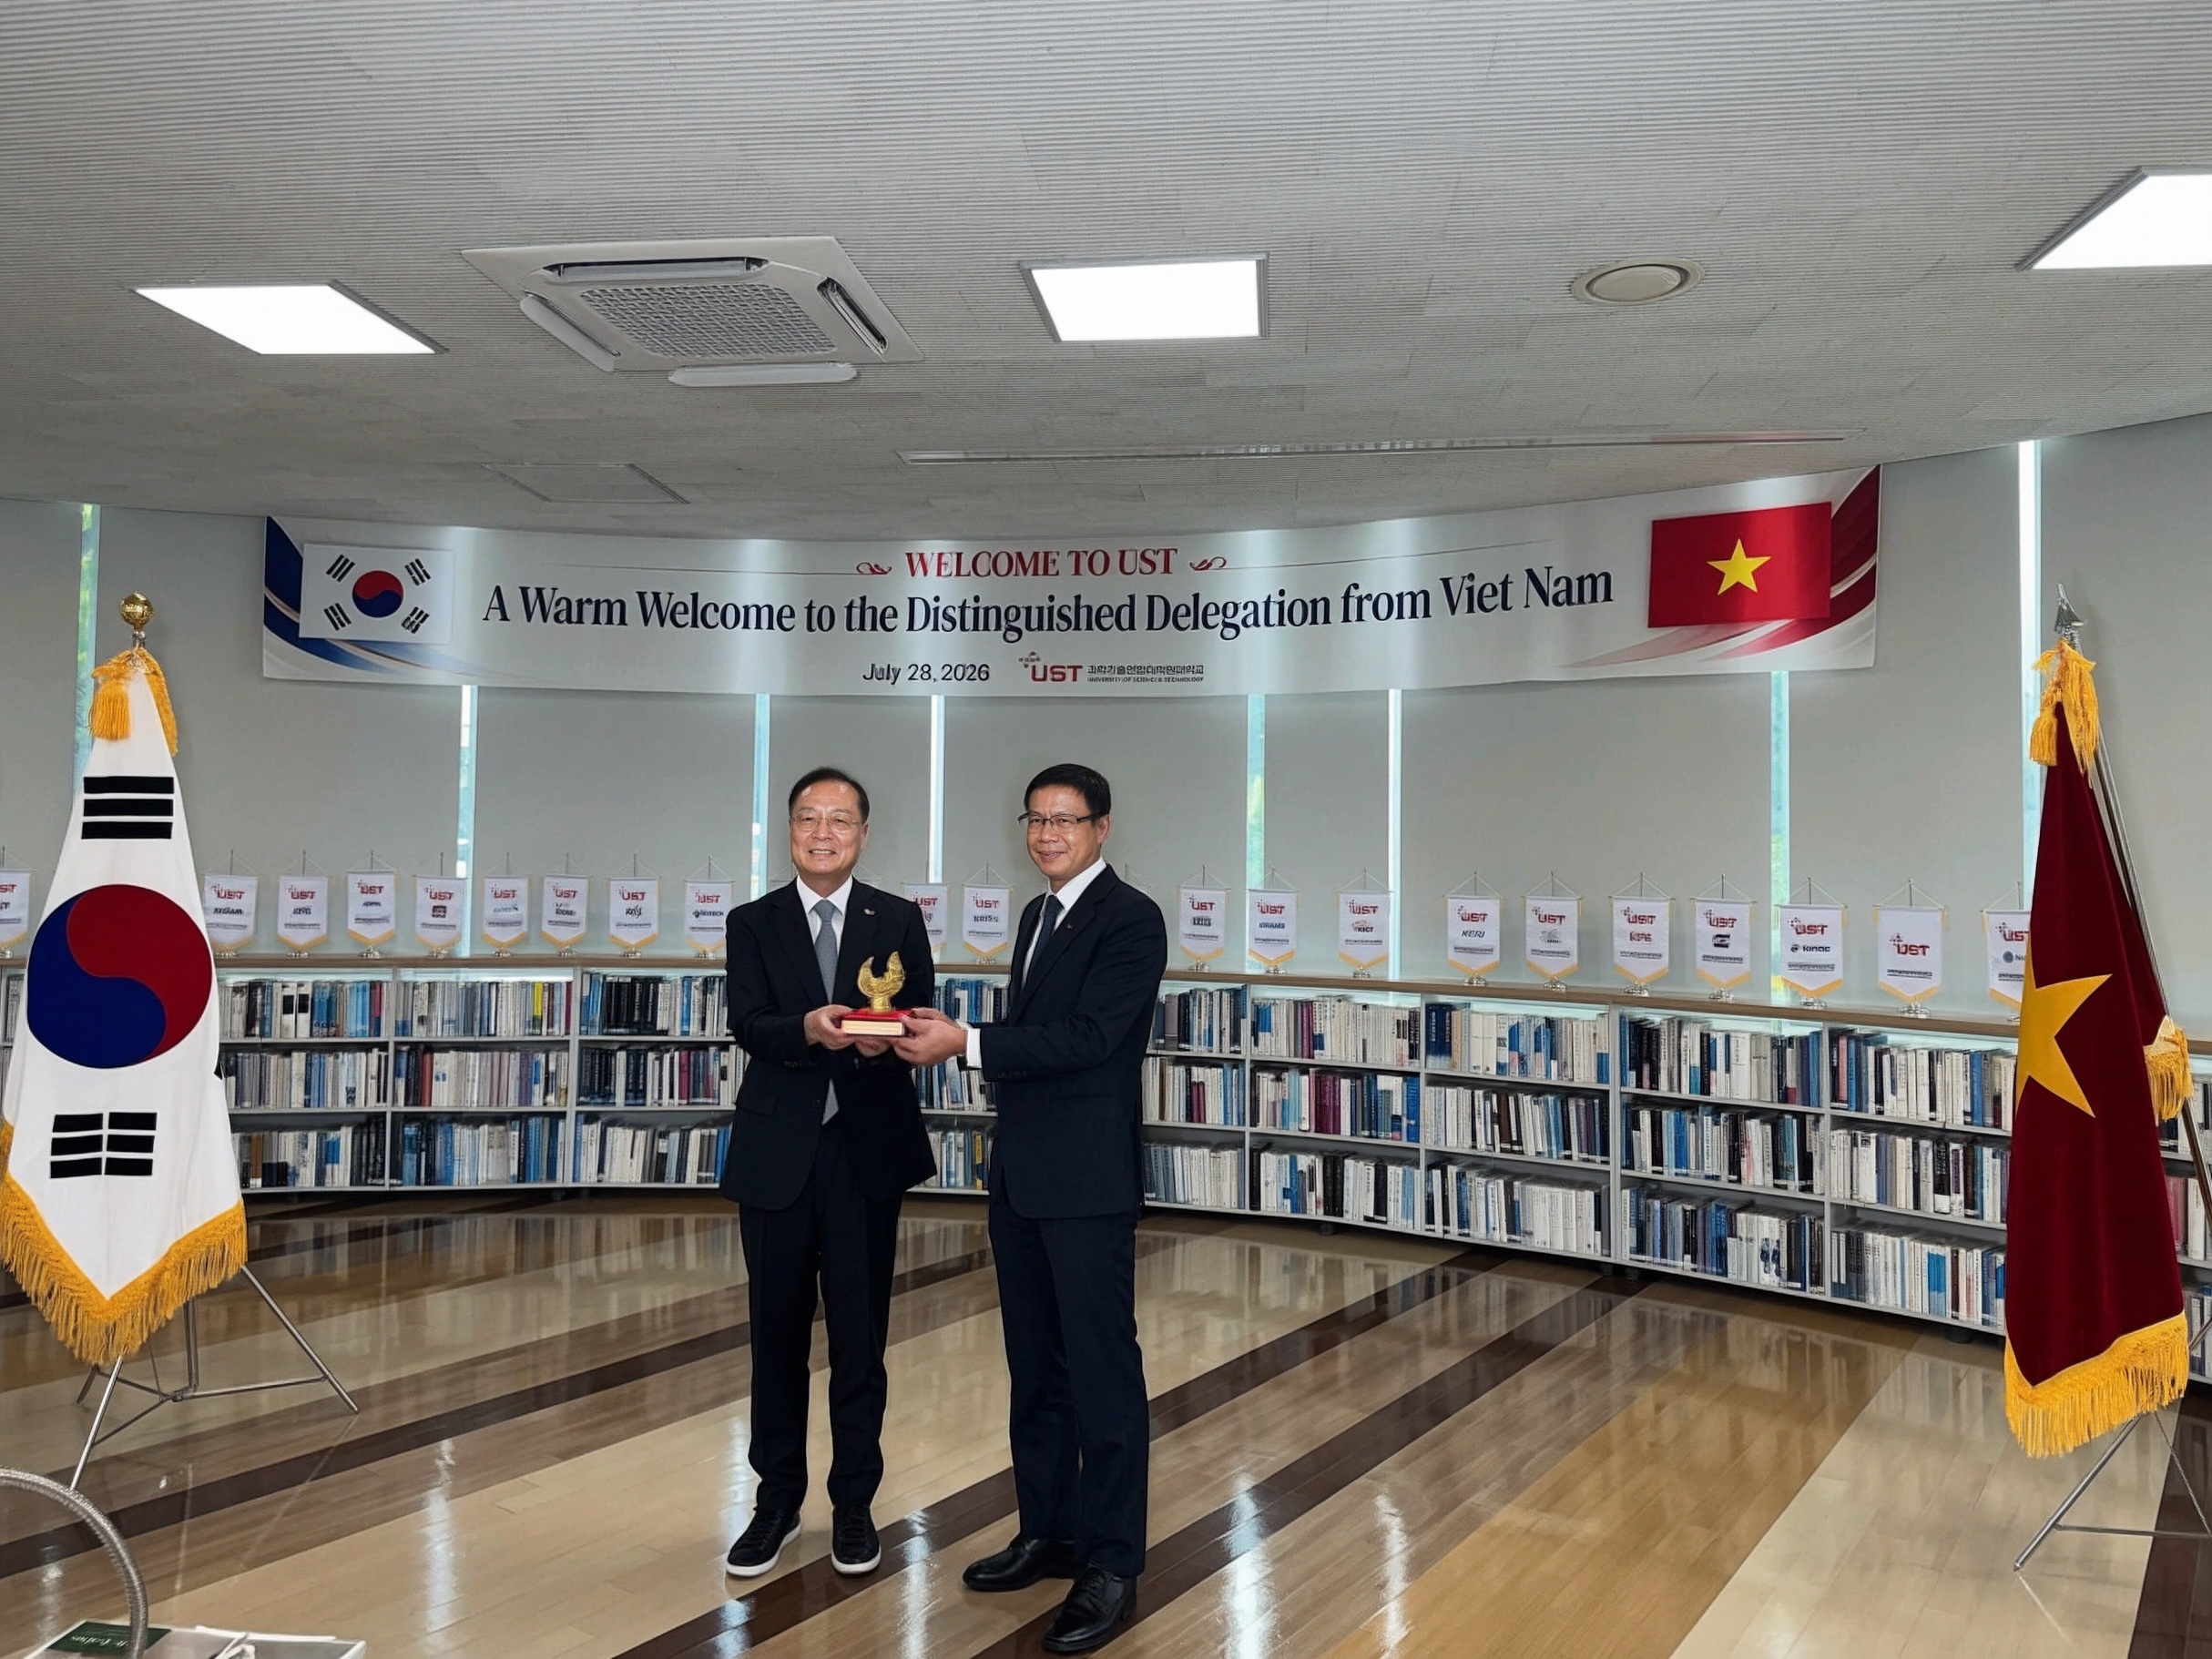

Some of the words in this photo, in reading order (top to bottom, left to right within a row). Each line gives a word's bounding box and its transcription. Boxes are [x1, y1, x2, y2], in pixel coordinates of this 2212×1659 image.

[905, 551, 1060, 577] WELCOME
[1067, 550, 1110, 576] TO
[1118, 548, 1177, 575] UST
[483, 585, 510, 622] A
[519, 586, 627, 626] Warm
[637, 591, 795, 630] Welcome
[805, 597, 835, 632] to
[844, 595, 898, 632] the
[907, 594, 1135, 644] Distinguished
[1147, 588, 1330, 641] Delegation
[1341, 583, 1431, 623] from
[1440, 573, 1513, 616] Viet
[1524, 566, 1612, 608] Nam
[862, 663, 901, 686] July
[908, 664, 937, 684] 28,
[942, 664, 990, 682] 2026
[1032, 665, 1083, 682] UST
[0, 884, 16, 892] ST
[361, 885, 384, 894] UST
[217, 891, 245, 900] UST
[291, 891, 316, 900] UST
[429, 891, 454, 901] UST
[494, 890, 517, 899] UST
[555, 890, 577, 899] UST
[621, 891, 646, 901] UST
[698, 895, 720, 903] UST
[975, 900, 1000, 909] UST
[1191, 901, 1216, 911] UST
[1260, 905, 1285, 914] UST
[1352, 905, 1379, 914] UST
[1461, 912, 1488, 922] UST
[1538, 913, 1565, 924] UST
[1627, 914, 1656, 924] UST
[1709, 917, 1737, 928] UST
[1795, 924, 1828, 935] UST
[1897, 944, 1930, 956] UST
